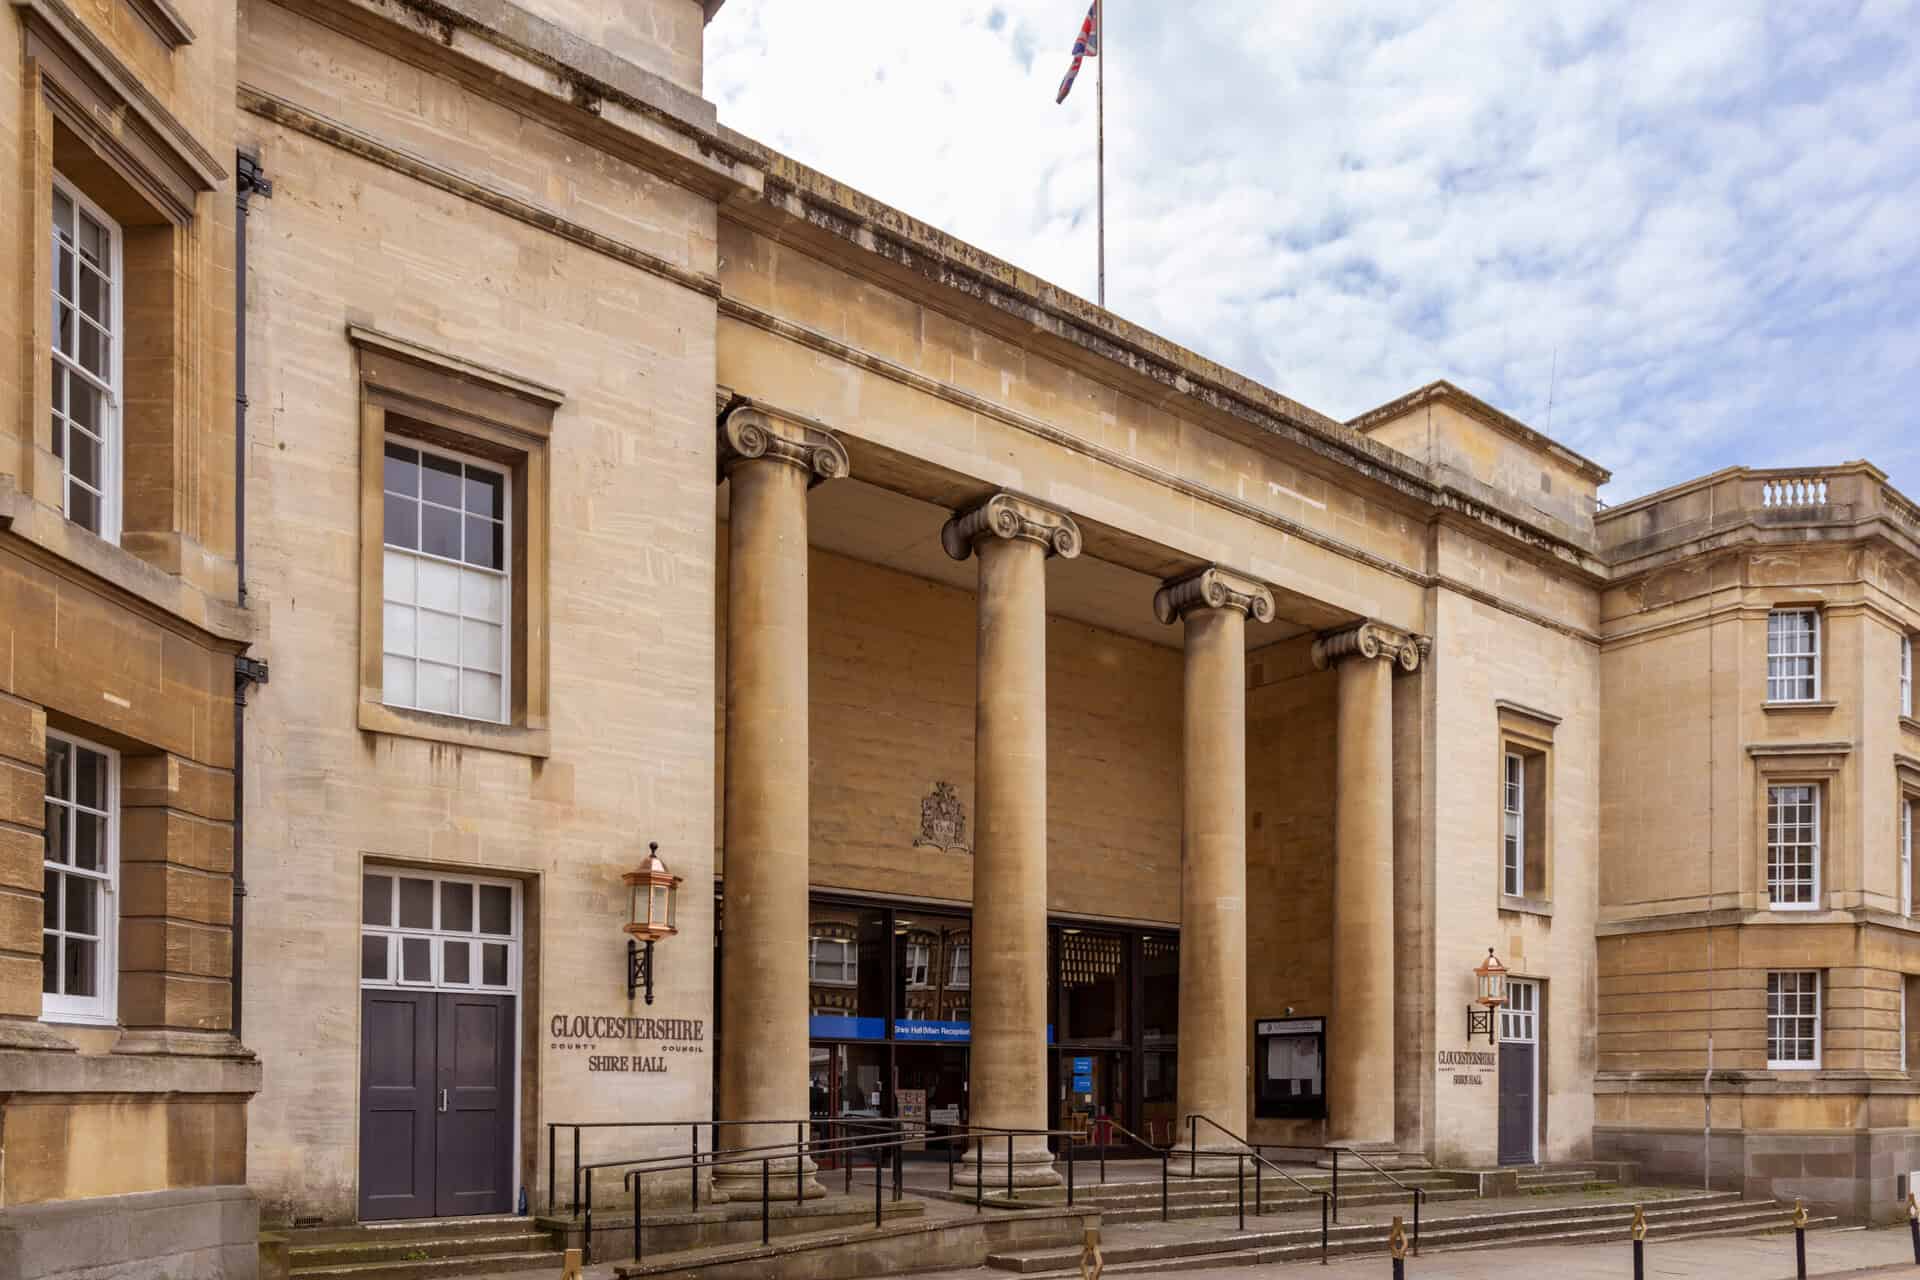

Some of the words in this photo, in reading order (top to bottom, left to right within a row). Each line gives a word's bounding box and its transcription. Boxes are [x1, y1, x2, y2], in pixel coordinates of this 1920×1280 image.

[551, 1015, 703, 1040] GLOUCESTERSHIRE
[661, 1045, 704, 1053] COUNCIL
[588, 1056, 629, 1072] SHIRE
[632, 1056, 668, 1072] HALL
[1438, 1051, 1496, 1065] GLOUCESTERSHIRE
